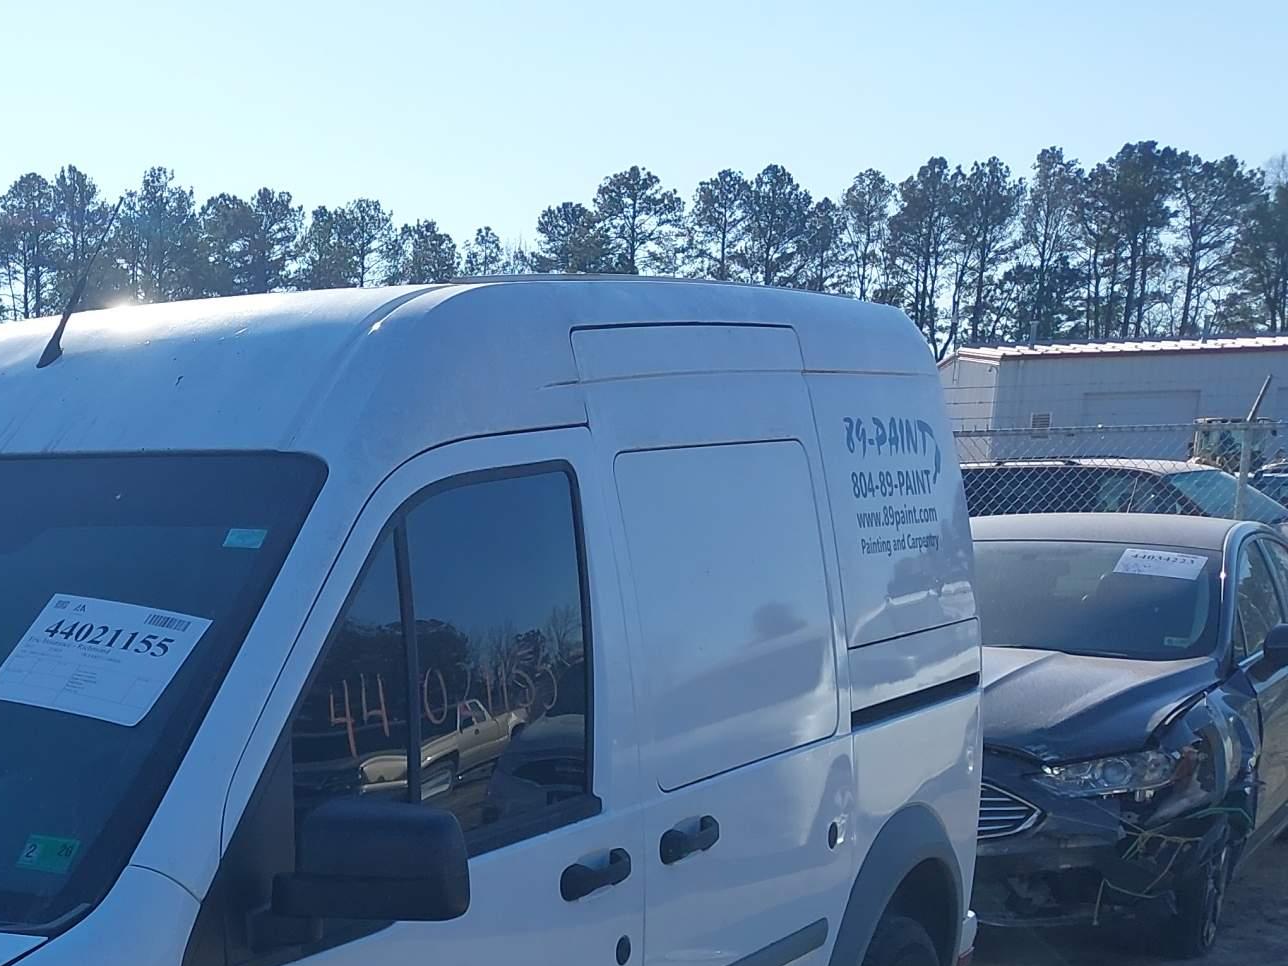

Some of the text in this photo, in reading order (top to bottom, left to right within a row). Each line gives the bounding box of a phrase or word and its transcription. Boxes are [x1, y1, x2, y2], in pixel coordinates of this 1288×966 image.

[843, 416, 941, 484] 89-PAINT
[851, 469, 932, 499] 804-89-PAINT
[856, 504, 938, 531] www.89paint.com
[861, 538, 892, 556] Painting
[893, 534, 906, 552] and
[44, 618, 175, 658] 44021155
